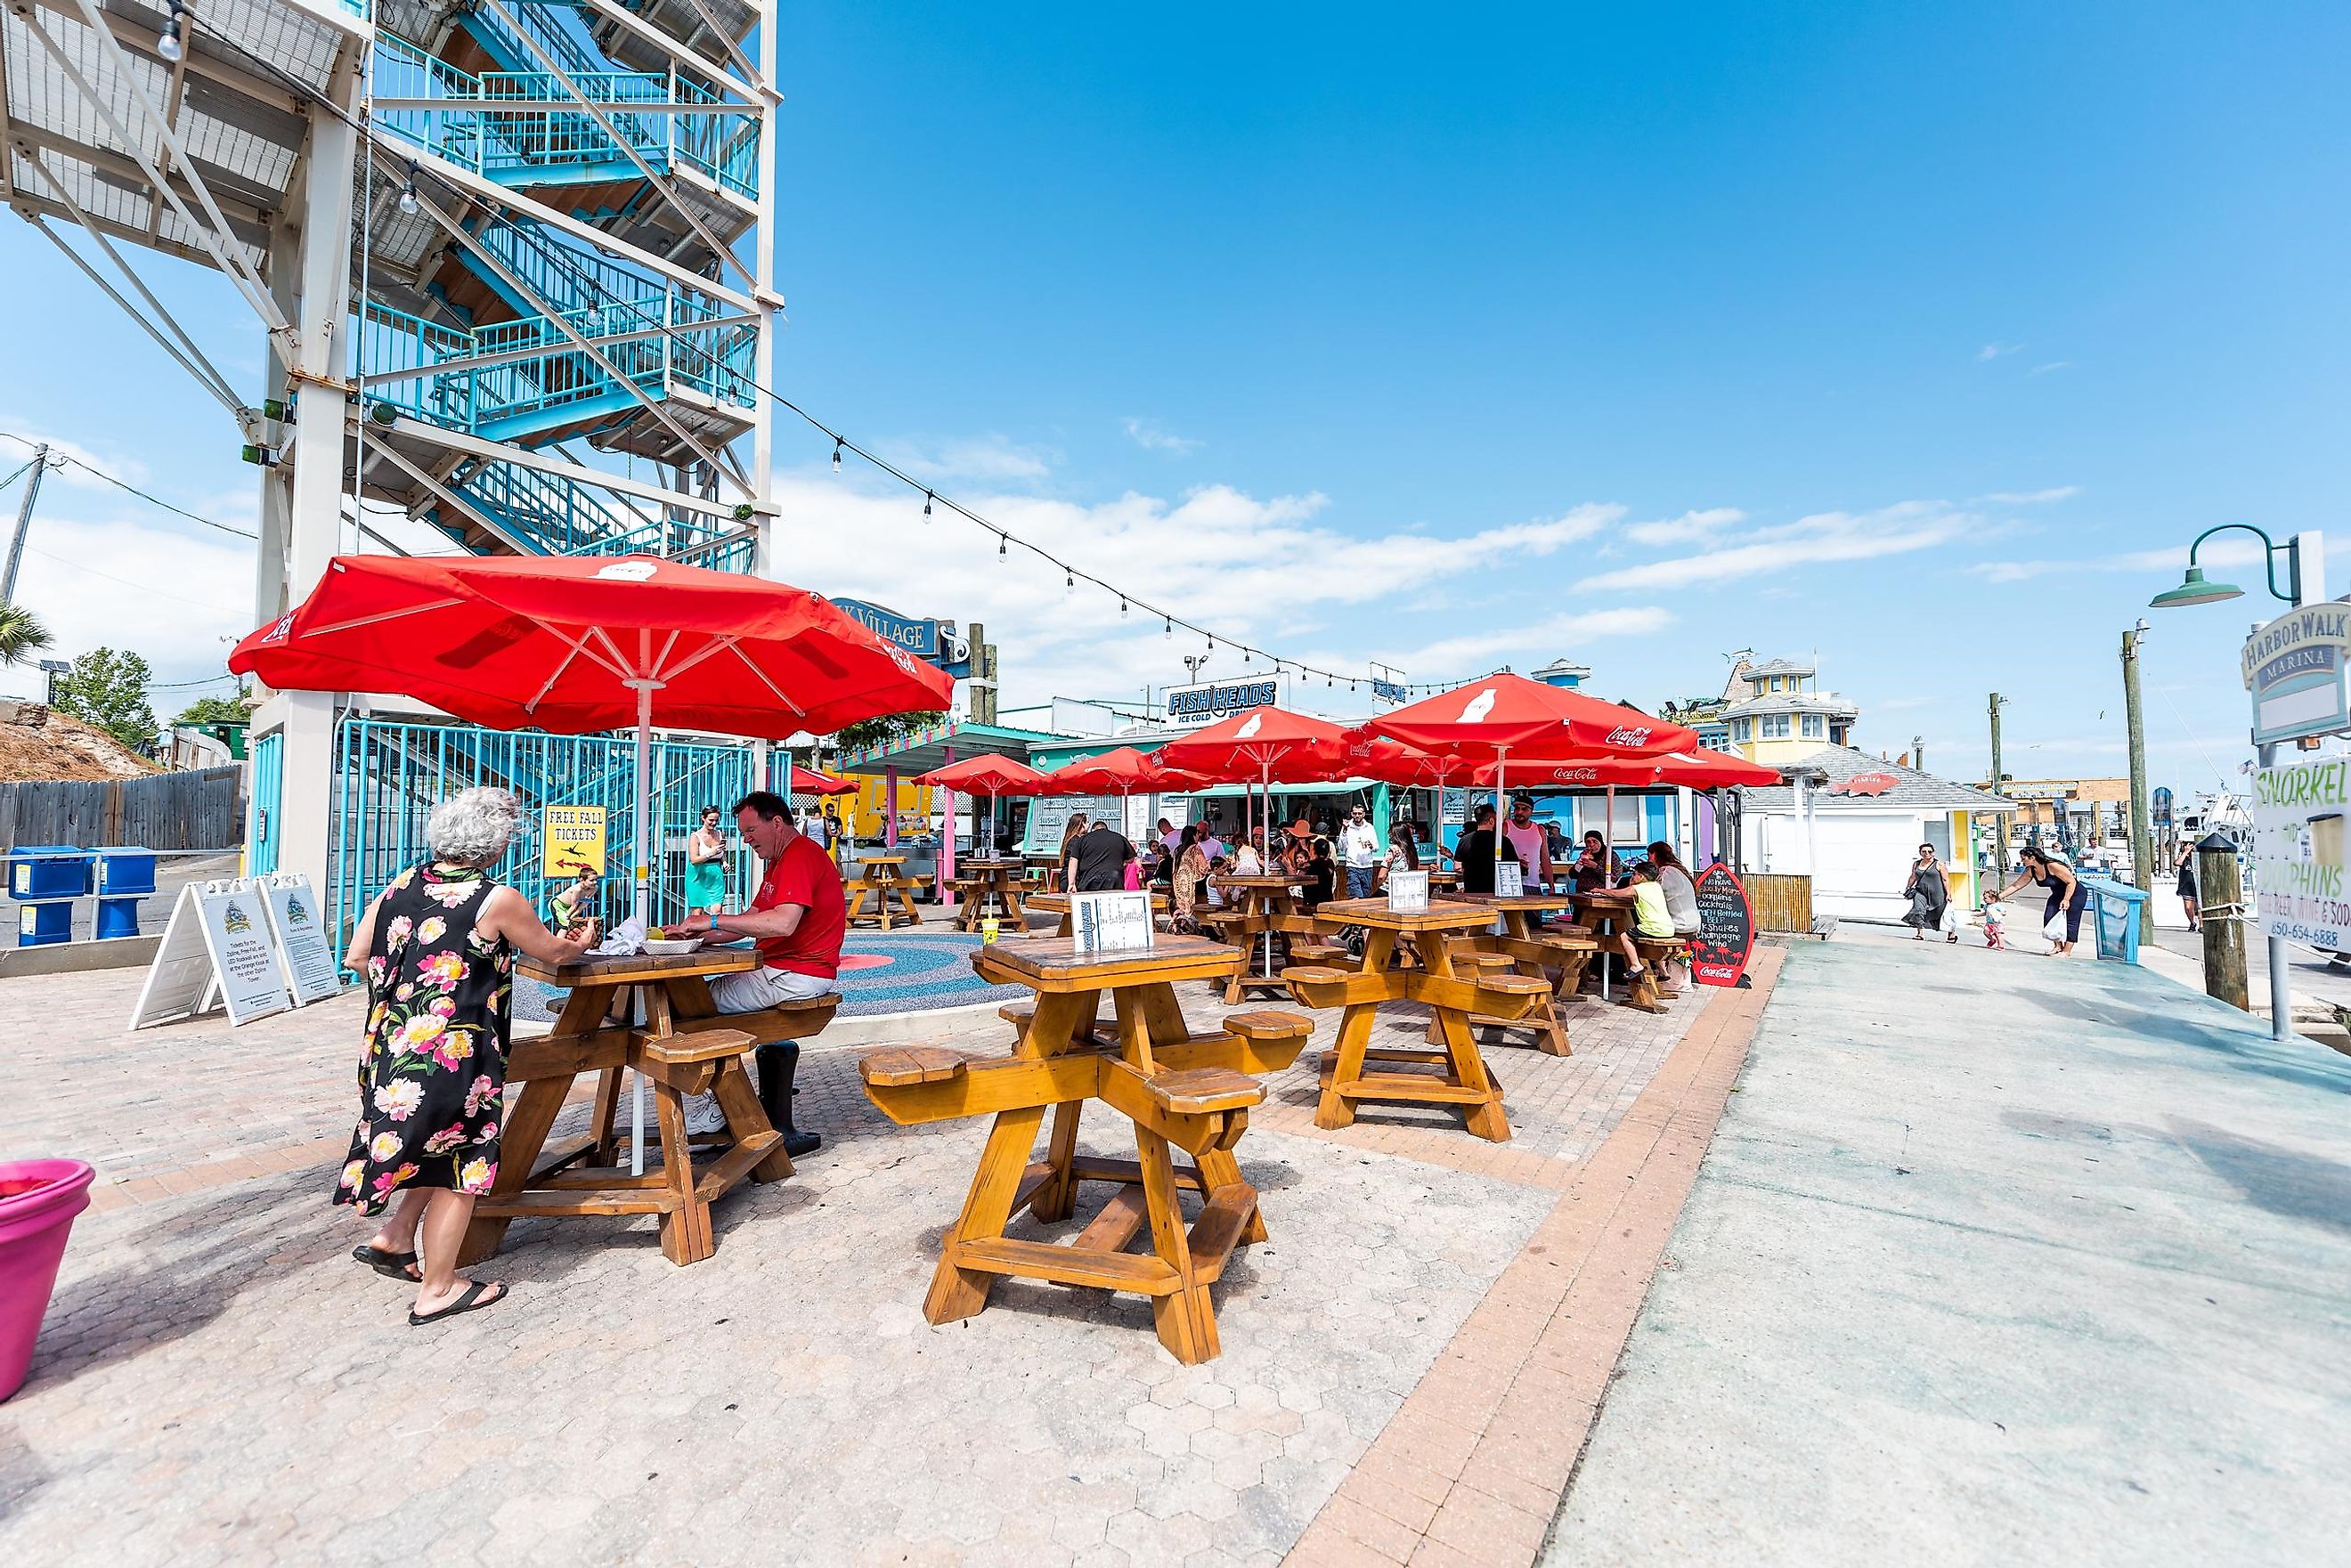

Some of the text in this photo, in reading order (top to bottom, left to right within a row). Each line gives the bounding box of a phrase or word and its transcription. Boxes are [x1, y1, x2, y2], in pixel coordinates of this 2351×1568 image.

[2266, 650, 2325, 681] MARINA
[1168, 681, 1276, 716] FISH HEADS
[1178, 715, 1190, 723] ICE
[1192, 713, 1211, 722] COLD
[1606, 726, 1652, 747] Coca-Cola
[1553, 768, 1598, 780] Coca-Cola
[2257, 763, 2348, 808] SNORKEL
[549, 811, 603, 824] FREE FALL
[555, 828, 597, 841] TICKETS
[2322, 901, 2328, 922] &
[2331, 901, 2351, 926] SOD
[1696, 931, 1741, 943] Champagne
[2272, 921, 2338, 946] 850-654-6888
[1699, 966, 1734, 979] Coca-Cola
